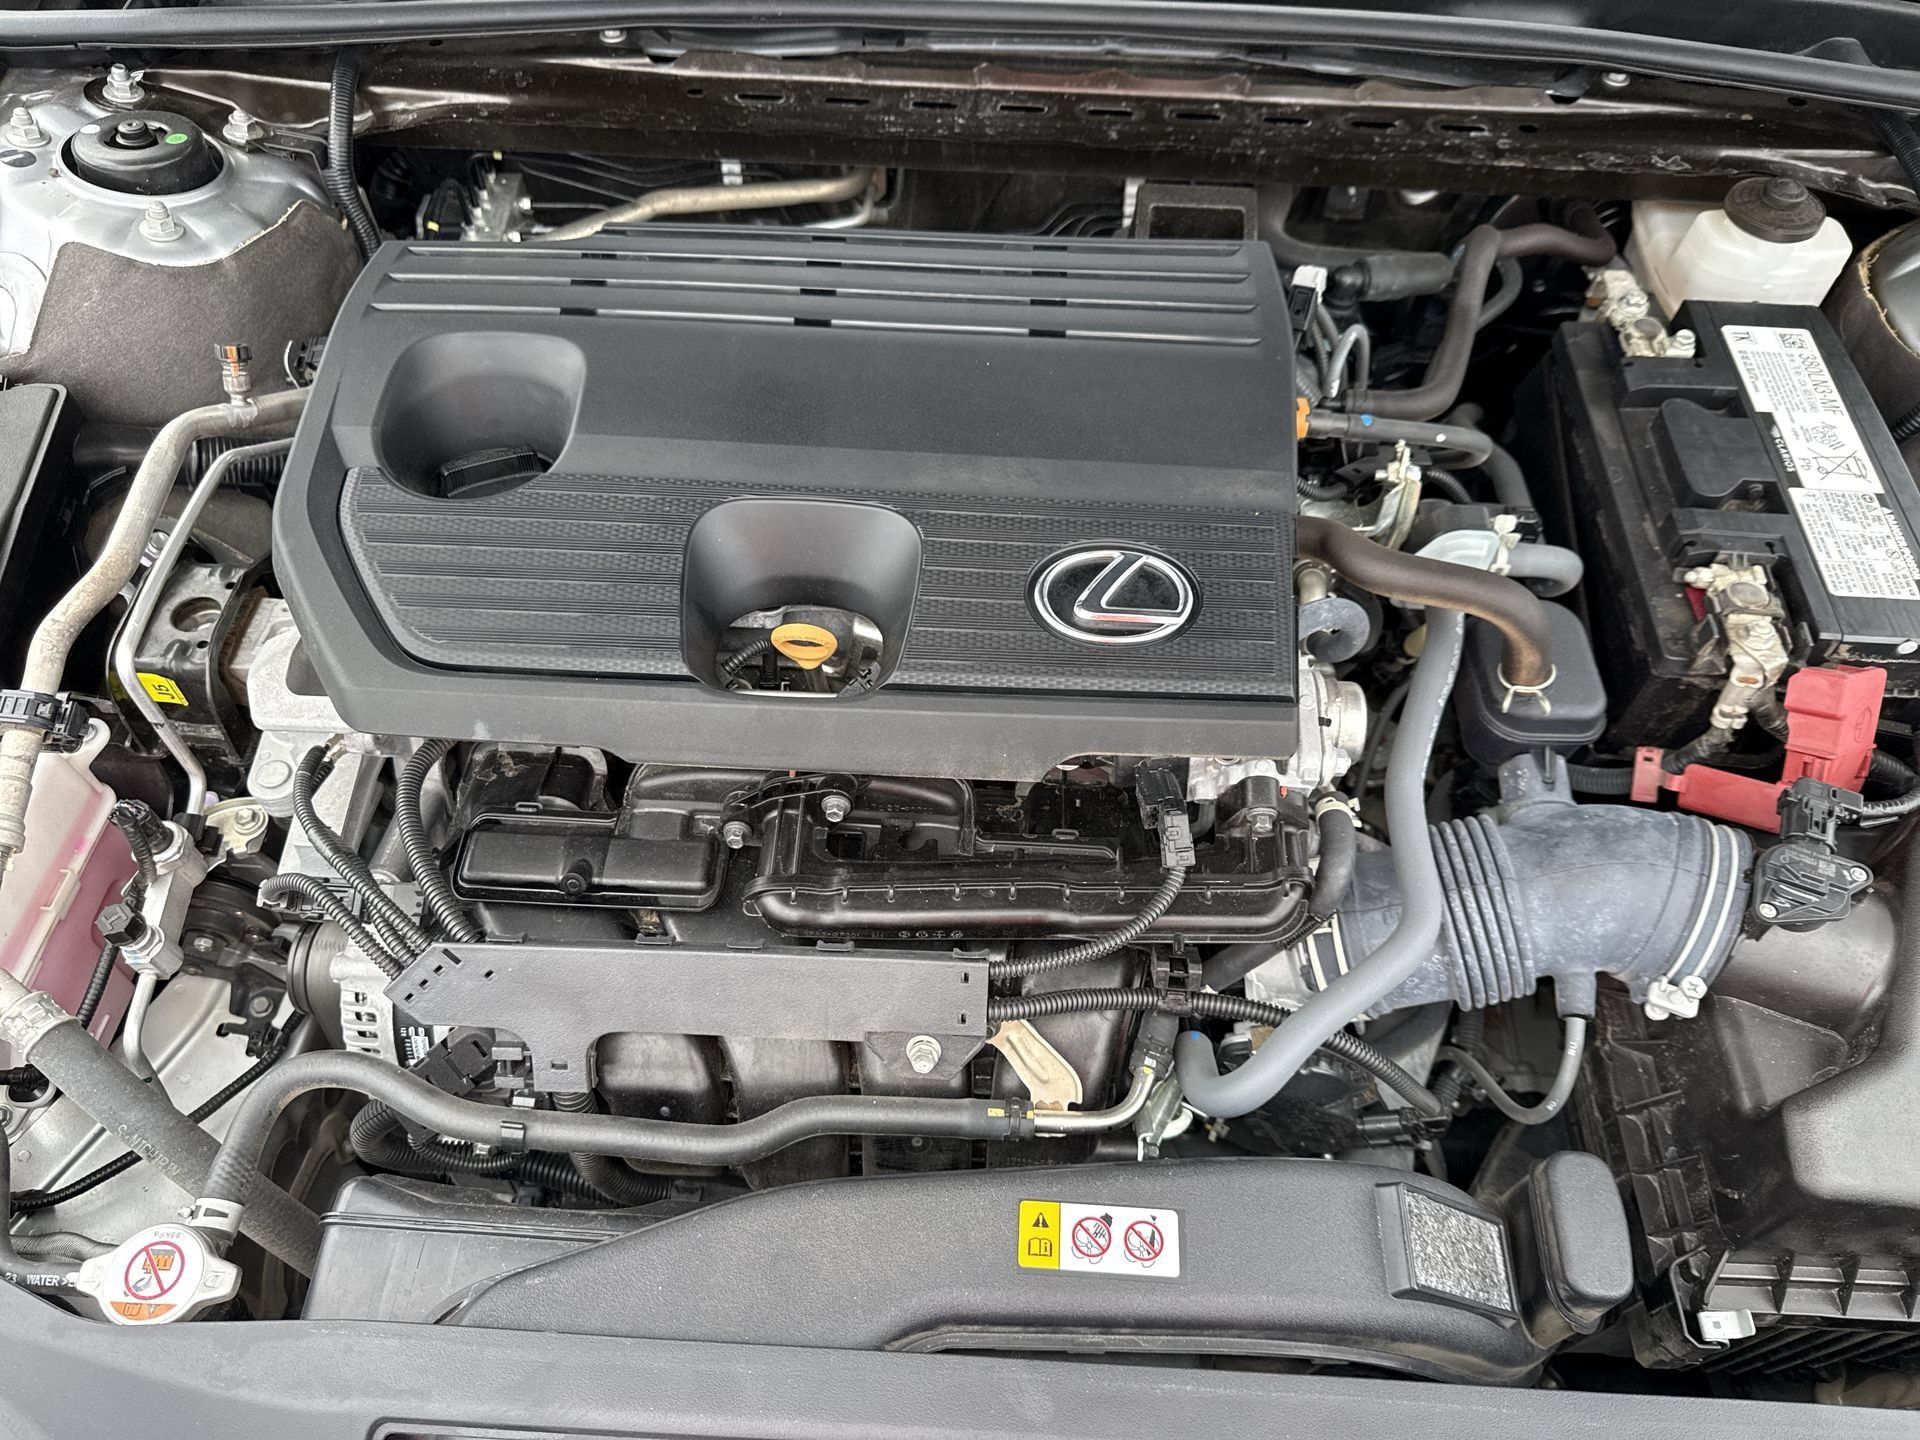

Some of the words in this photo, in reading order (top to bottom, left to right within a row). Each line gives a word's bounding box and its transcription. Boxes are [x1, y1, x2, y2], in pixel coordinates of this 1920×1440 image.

[1799, 353, 1844, 417] 380LN3-MF
[1774, 438, 1796, 473] CLARIOS
[1797, 457, 1812, 471] Pb
[26, 1274, 60, 1288] WATER
